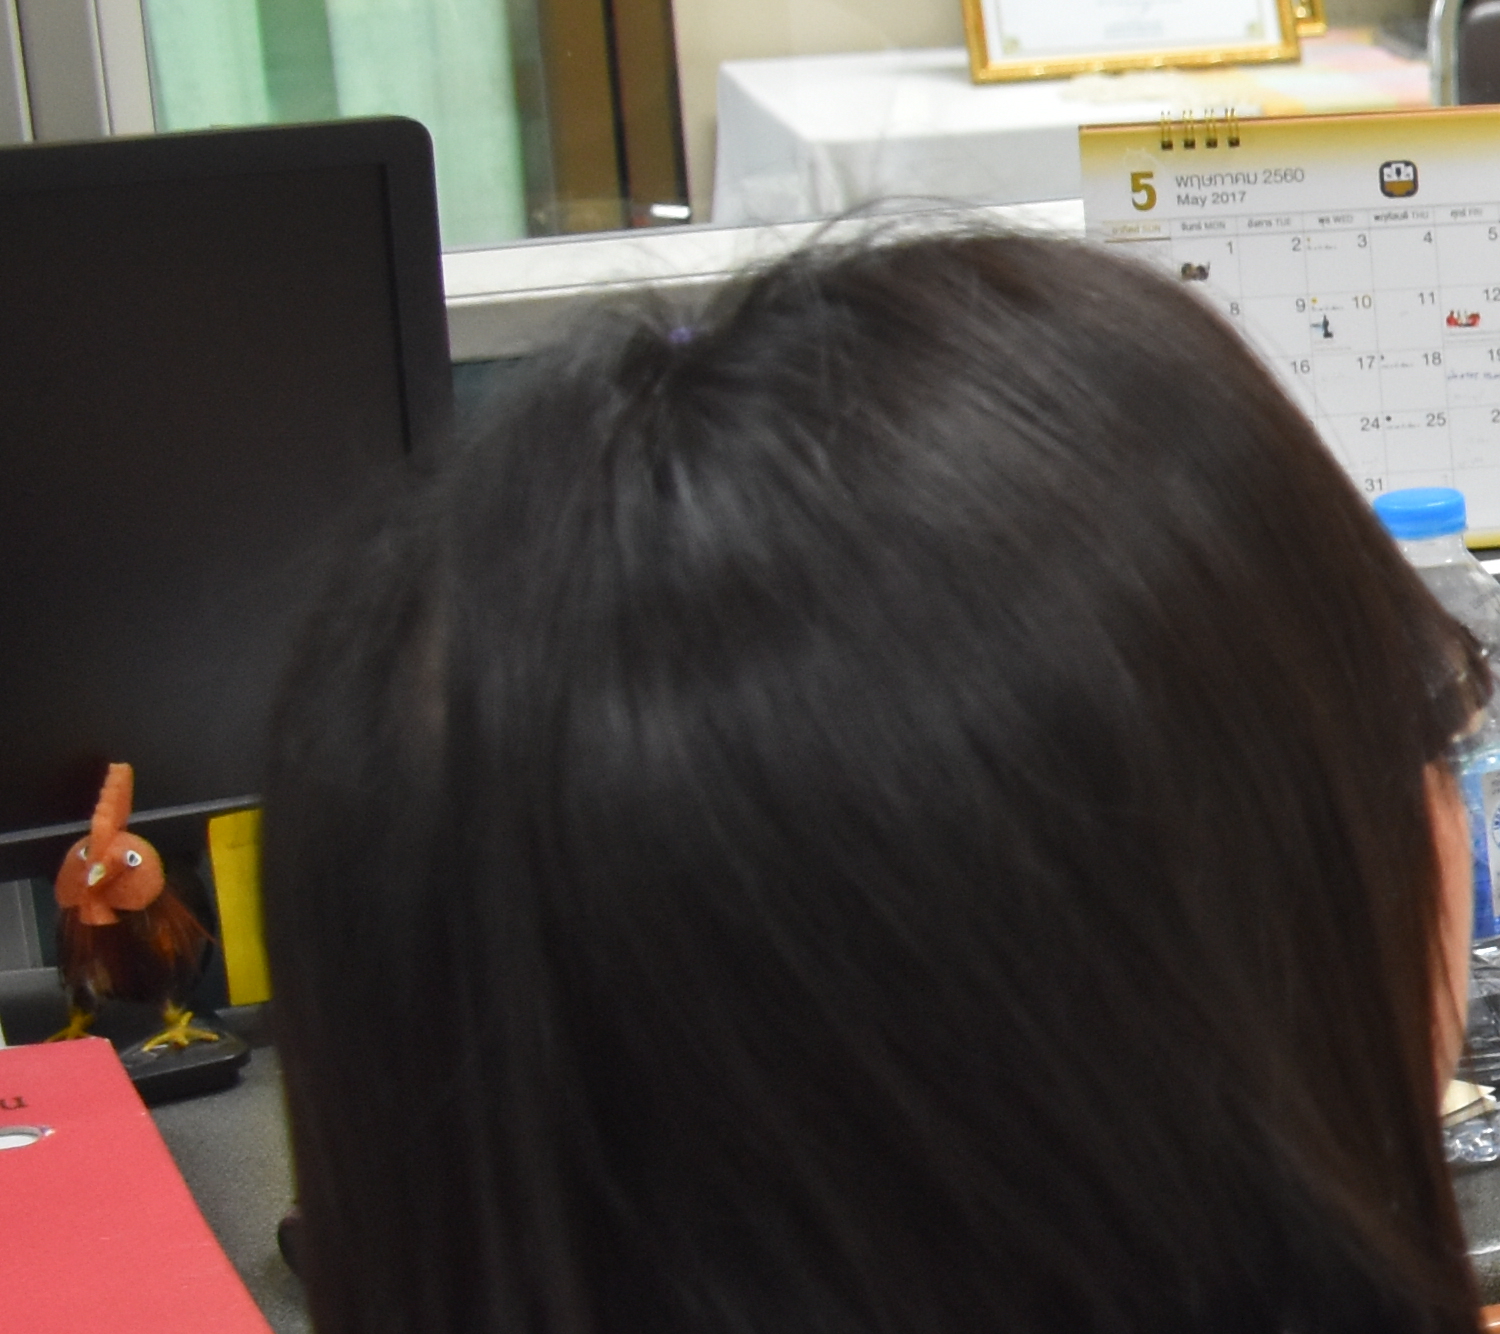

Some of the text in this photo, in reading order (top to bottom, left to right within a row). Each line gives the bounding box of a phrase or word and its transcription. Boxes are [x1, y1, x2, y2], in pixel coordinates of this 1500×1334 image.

[1130, 171, 1158, 211] 5
[1175, 168, 1305, 191] พฤษภาคม 2560
[1176, 191, 1246, 208] May 2017
[1226, 241, 1234, 255] 1
[1291, 237, 1302, 252] 2
[1357, 234, 1368, 248] 3
[1423, 231, 1433, 245] 4
[1488, 227, 1498, 241] 5
[1230, 302, 1240, 317] 8
[1295, 298, 1306, 313] 9
[1352, 295, 1373, 310] 10
[1418, 292, 1437, 306] 11
[1290, 360, 1311, 375] 16
[1357, 355, 1376, 370] 17
[1423, 351, 1442, 366] 18
[1360, 417, 1381, 432] 24
[1426, 413, 1447, 428] 25
[1364, 478, 1385, 493] 31
